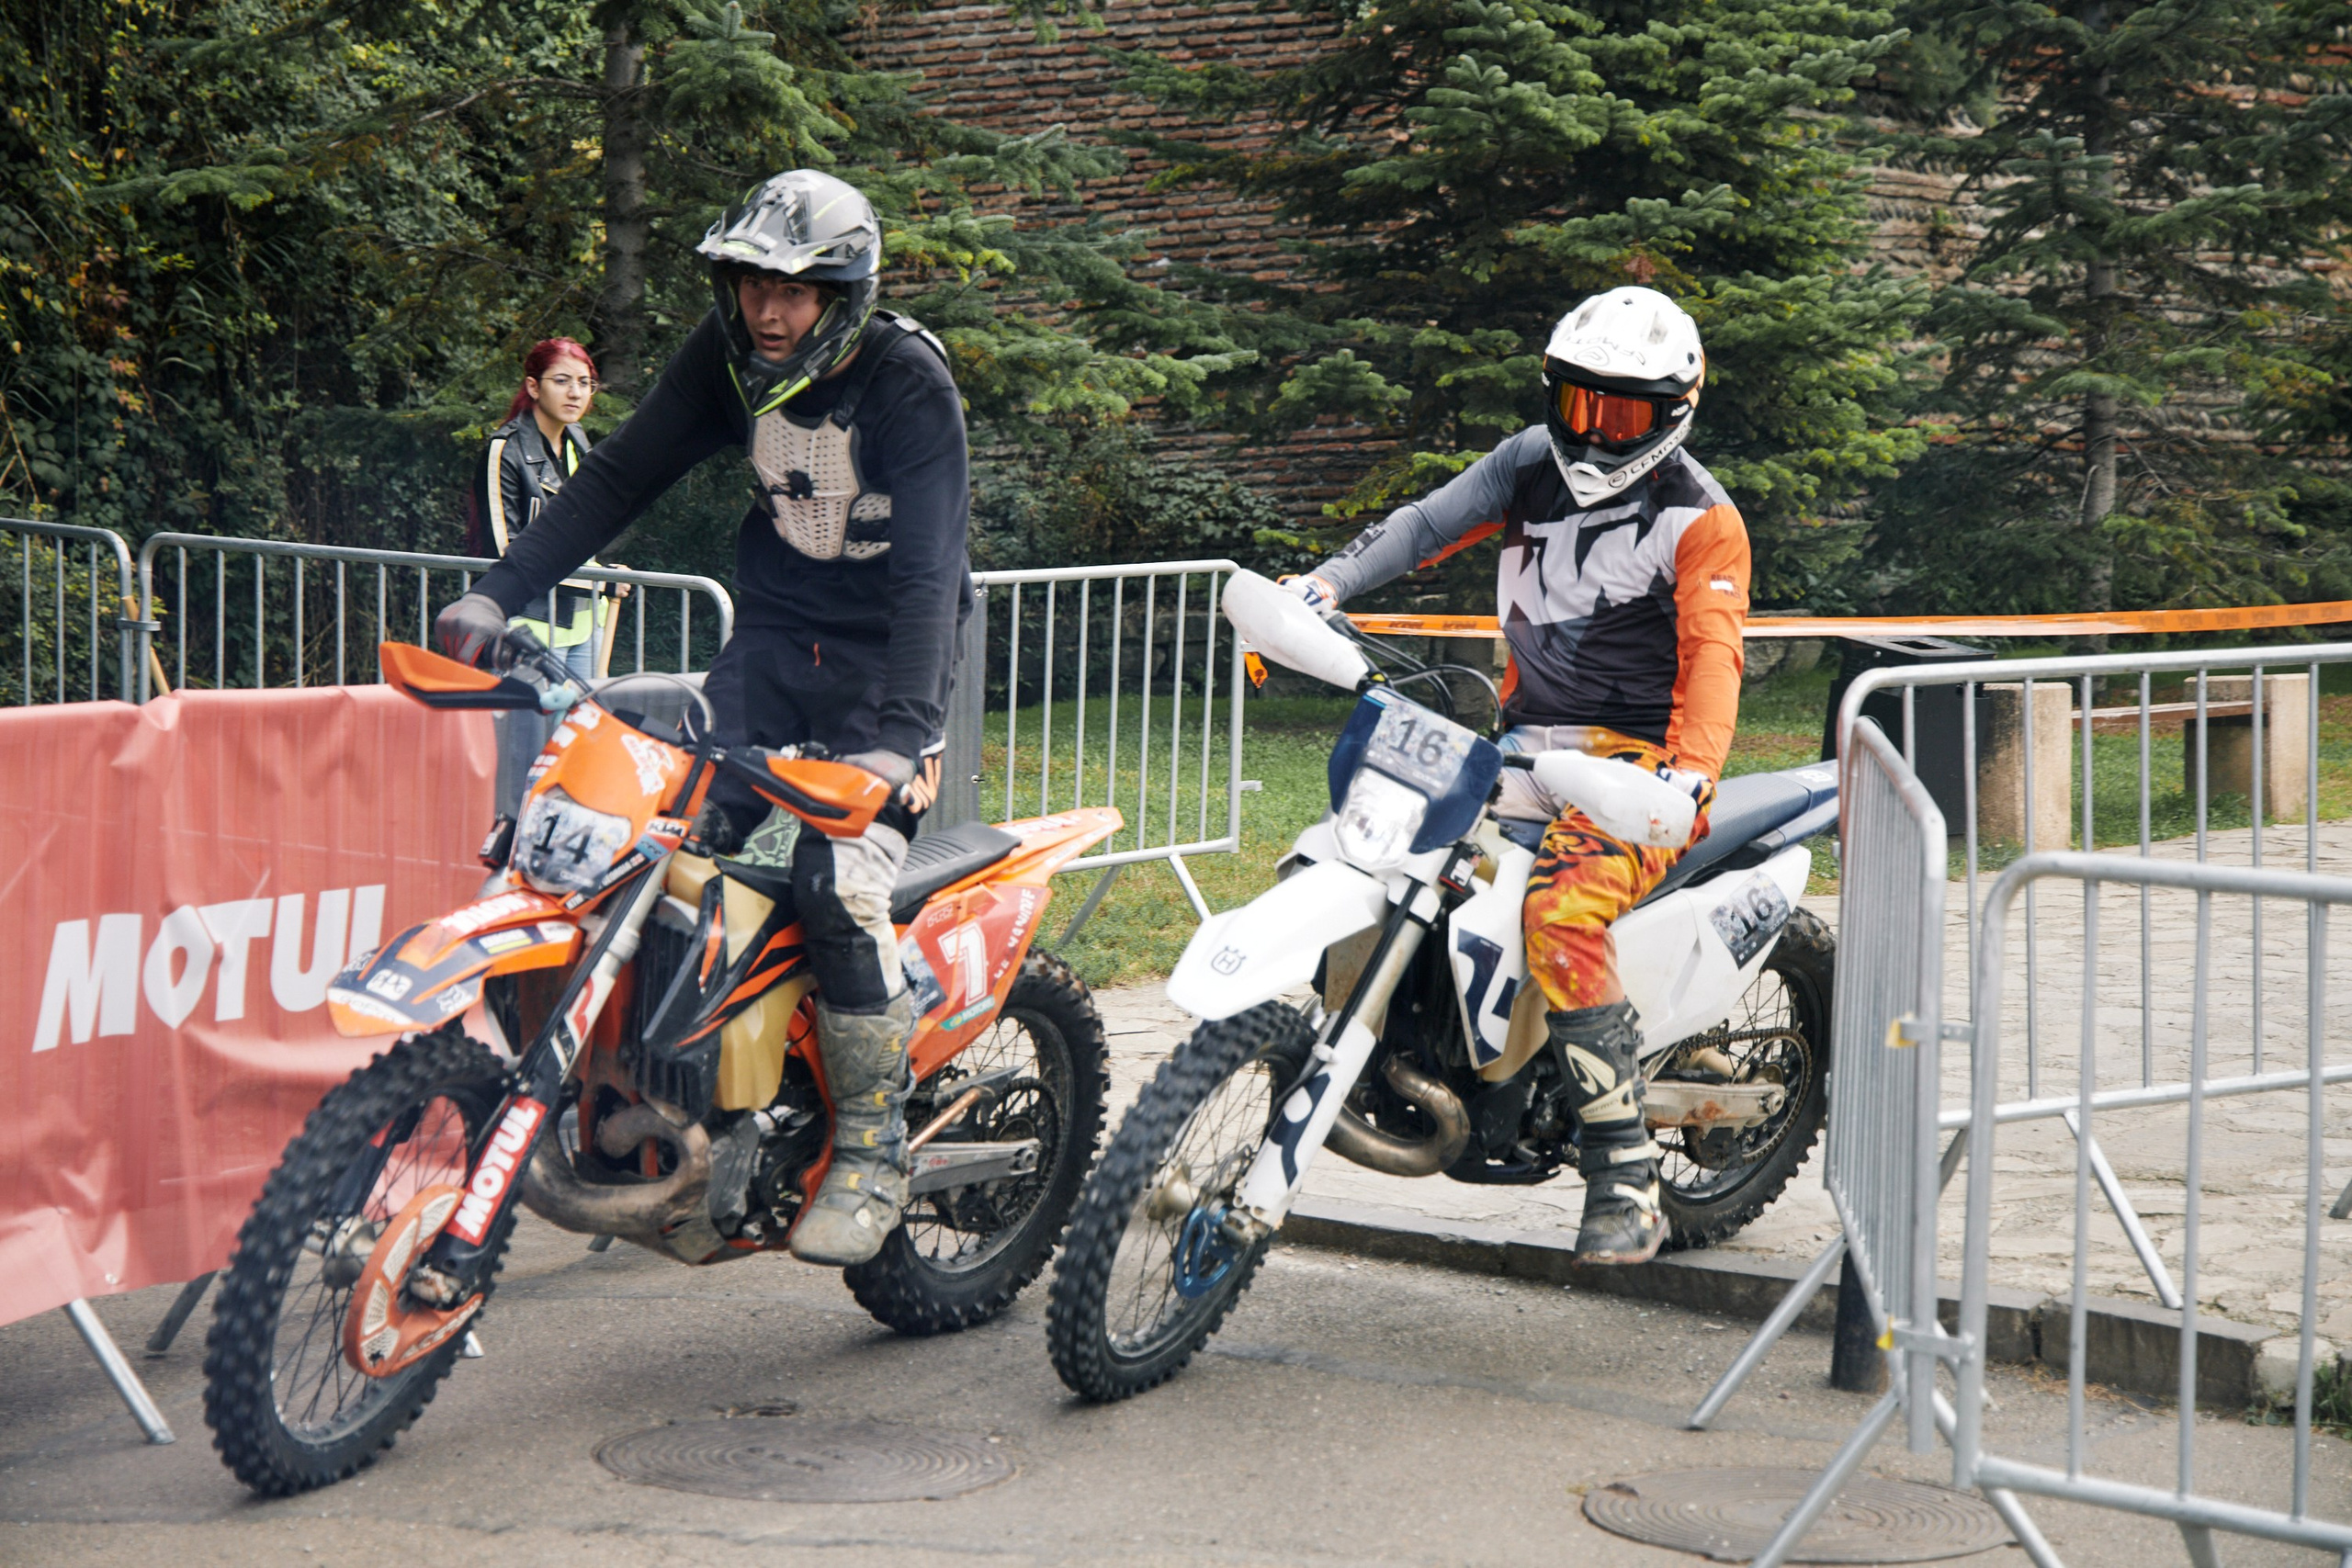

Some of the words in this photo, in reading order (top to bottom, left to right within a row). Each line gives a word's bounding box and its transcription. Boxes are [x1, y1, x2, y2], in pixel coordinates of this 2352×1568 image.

[1387, 719, 1448, 766] 16
[533, 815, 591, 865] 14
[649, 820, 684, 837] KTM
[1730, 887, 1773, 942] 16
[456, 1103, 537, 1238] MOTUL
